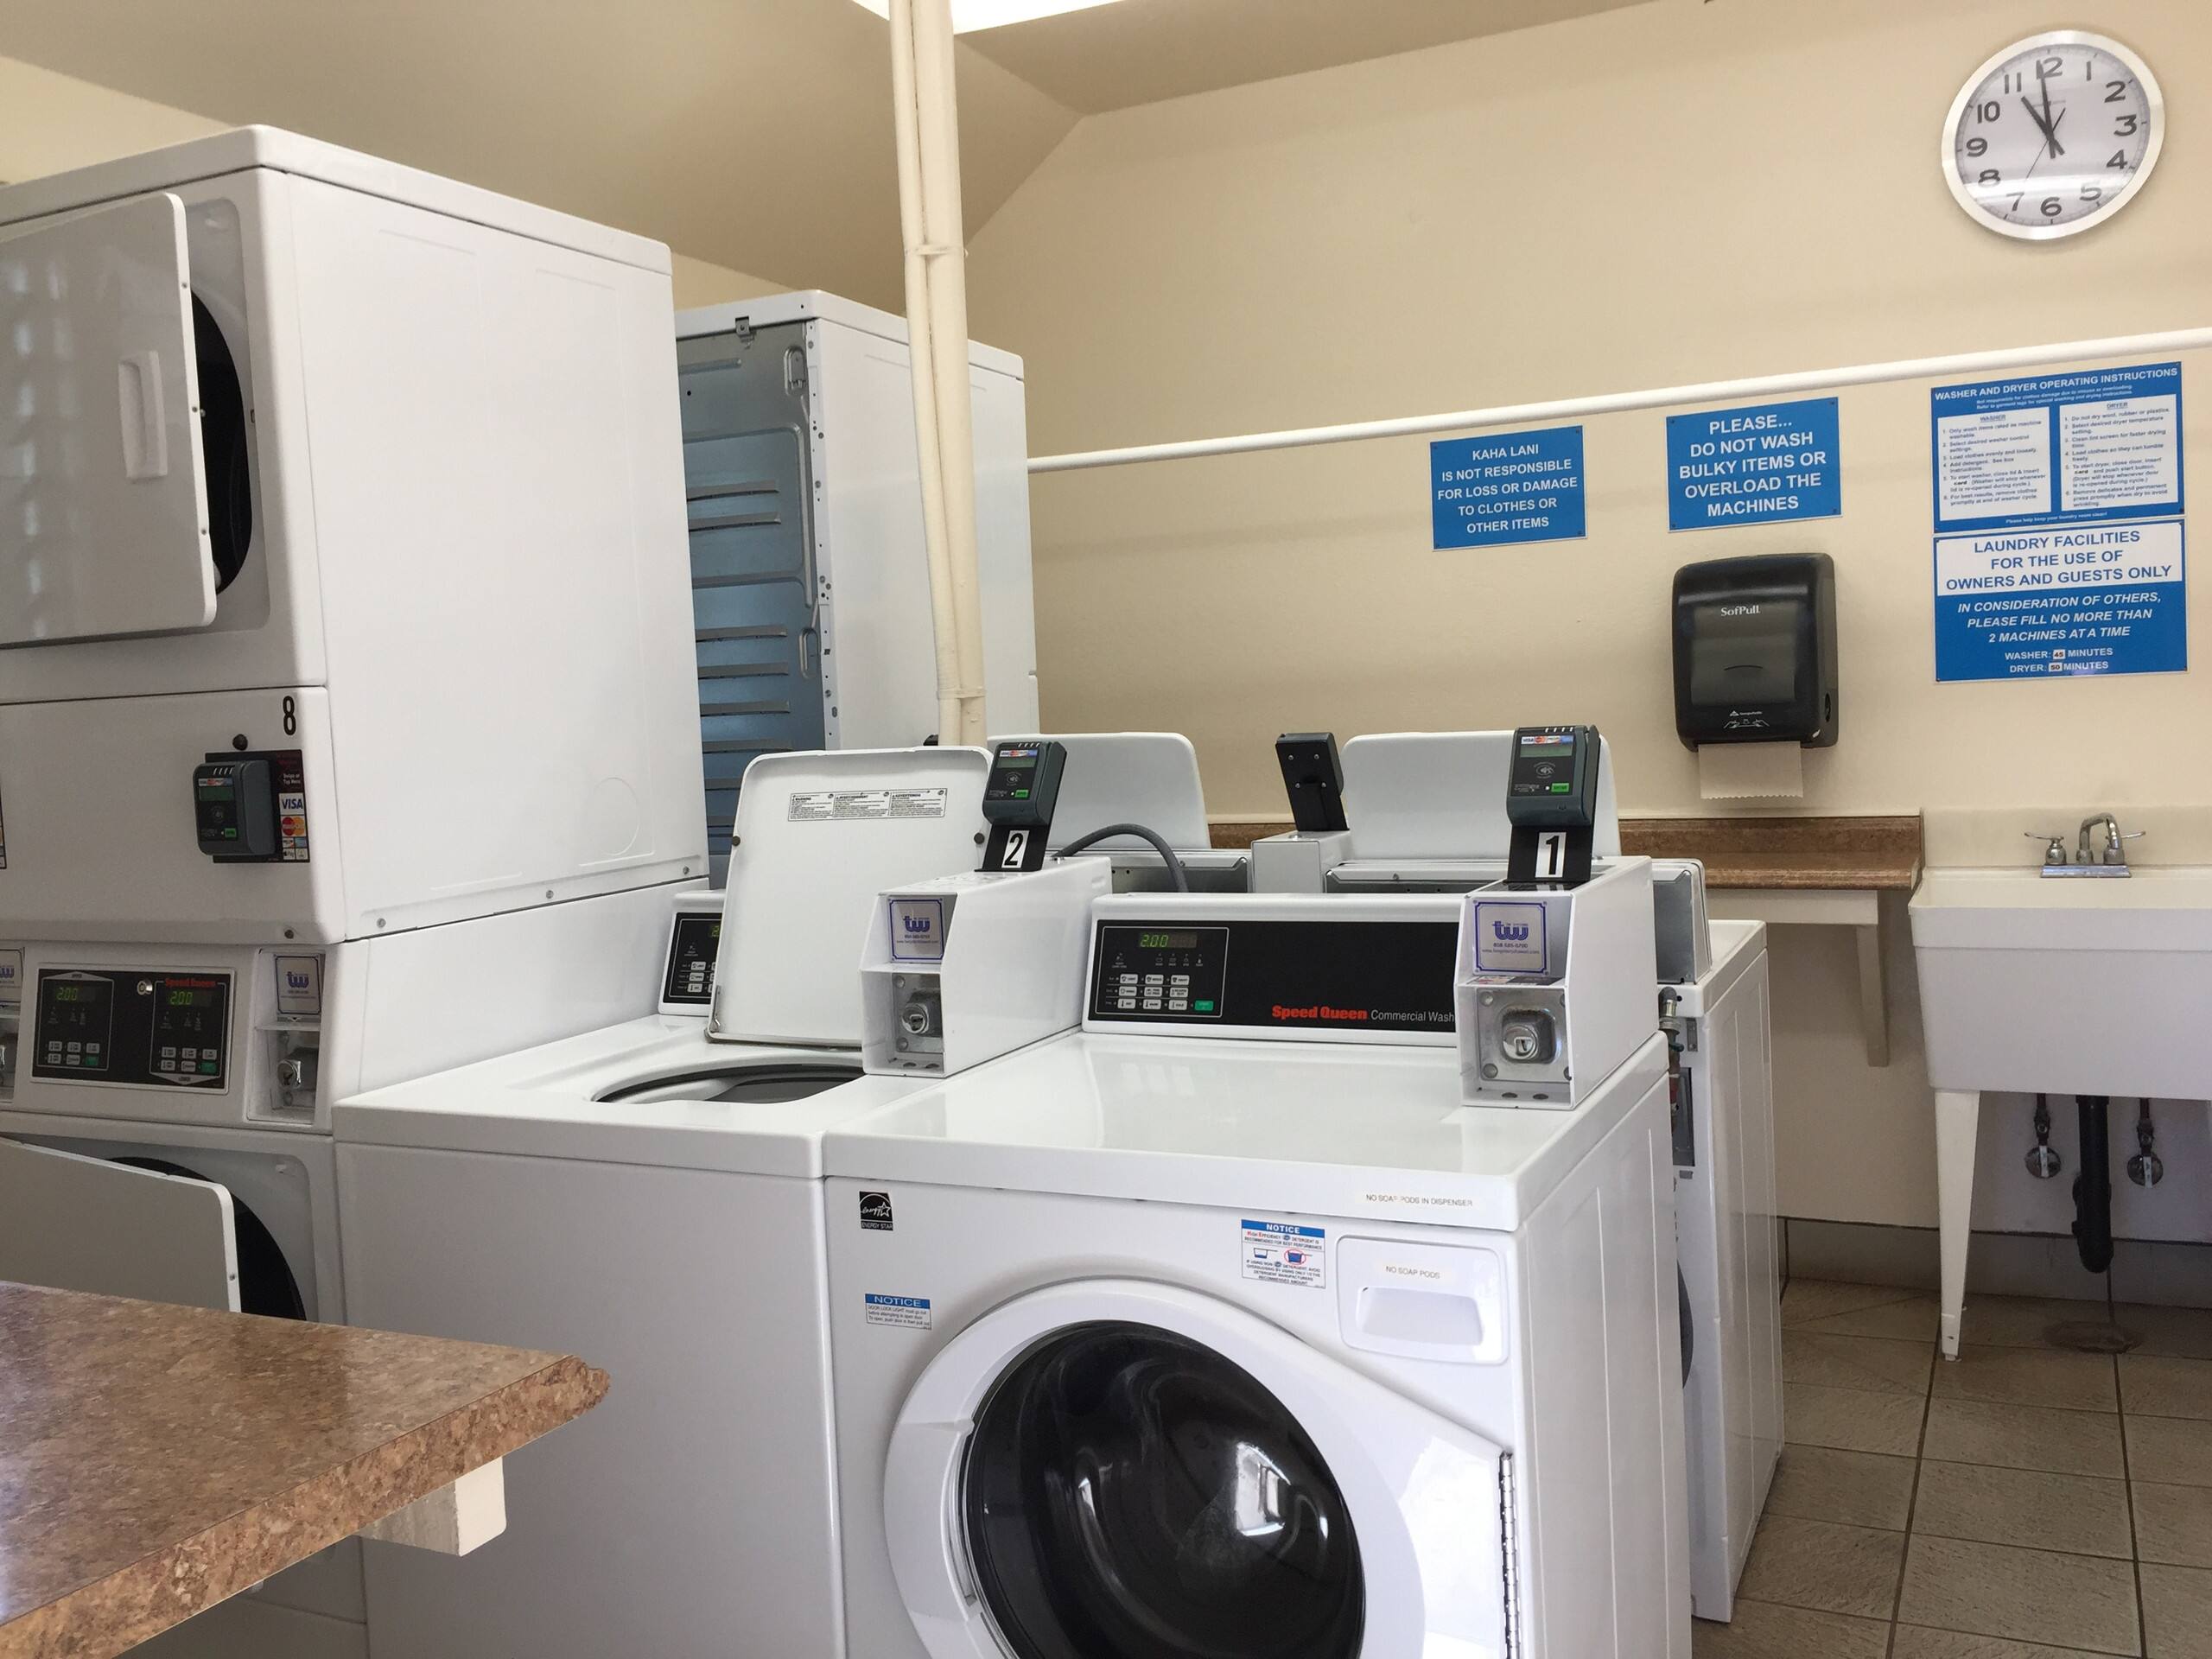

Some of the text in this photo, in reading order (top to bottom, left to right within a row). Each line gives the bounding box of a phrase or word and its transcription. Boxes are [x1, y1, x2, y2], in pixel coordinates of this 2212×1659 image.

[2086, 61, 2091, 80] 1
[2005, 73, 2021, 94] 11
[2104, 80, 2126, 102] 2
[1977, 101, 2000, 124] 10
[2113, 114, 2137, 137] 3
[1967, 137, 1987, 157] 9
[2107, 149, 2127, 169] 4
[1978, 169, 2000, 188] 8
[2080, 181, 2101, 201] 5
[2005, 192, 2024, 211] 7
[2040, 197, 2062, 216] 6
[1936, 389, 1977, 401] WASHER
[1980, 386, 2000, 396] AND
[2003, 382, 2037, 393] DRYER
[2039, 377, 2098, 389] OPERATING
[2101, 368, 2177, 383] INSTRUCTIONS
[1709, 415, 1792, 435] PLEASE...
[1472, 444, 1538, 461] KAHA LANI
[1691, 432, 1812, 457] DO NOT WASH
[1442, 459, 1572, 481] IS NOT RESPONSIBLE
[1680, 452, 1826, 479] BULKY ITEMS OR
[1438, 477, 1577, 499] FOR LOSS OR DAMAGE
[1686, 473, 1821, 499] OVERLOAD THE
[1459, 497, 1556, 516] TO CLOTHES OR
[1708, 496, 1798, 517] MACHINES
[1467, 517, 1548, 533] OTHER ITEMS
[1975, 531, 2140, 553] LAUNDRY FACILITIES
[1992, 550, 2122, 569] FOR THE USE OF
[1947, 565, 2171, 589] OWNERS AND GUESTS ONLY
[1721, 605, 1760, 617] SofPull
[1958, 592, 2160, 613] IN CONSIDERATION OF OTHERS,
[1968, 609, 2152, 627] PLEASE FILL NO MORE THAN
[1989, 626, 2131, 642] 2 MACHINES AT A TIME
[2005, 651, 2050, 660] WASHER:
[2069, 648, 2113, 658] MINUTES
[2010, 664, 2046, 673] DRYER:
[2064, 662, 2108, 671] MINUTES
[283, 696, 296, 735] 8
[282, 799, 302, 809] VISA
[1004, 833, 1023, 866] 2
[1546, 836, 1560, 874] 1
[1272, 1006, 1318, 1020] Speed
[1321, 1007, 1367, 1020] Queen
[1371, 1009, 1426, 1022] Commercial
[1267, 1224, 1300, 1234] NOTICE
[1420, 1270, 1440, 1279] PODS
[874, 1296, 922, 1306] NOTICE
